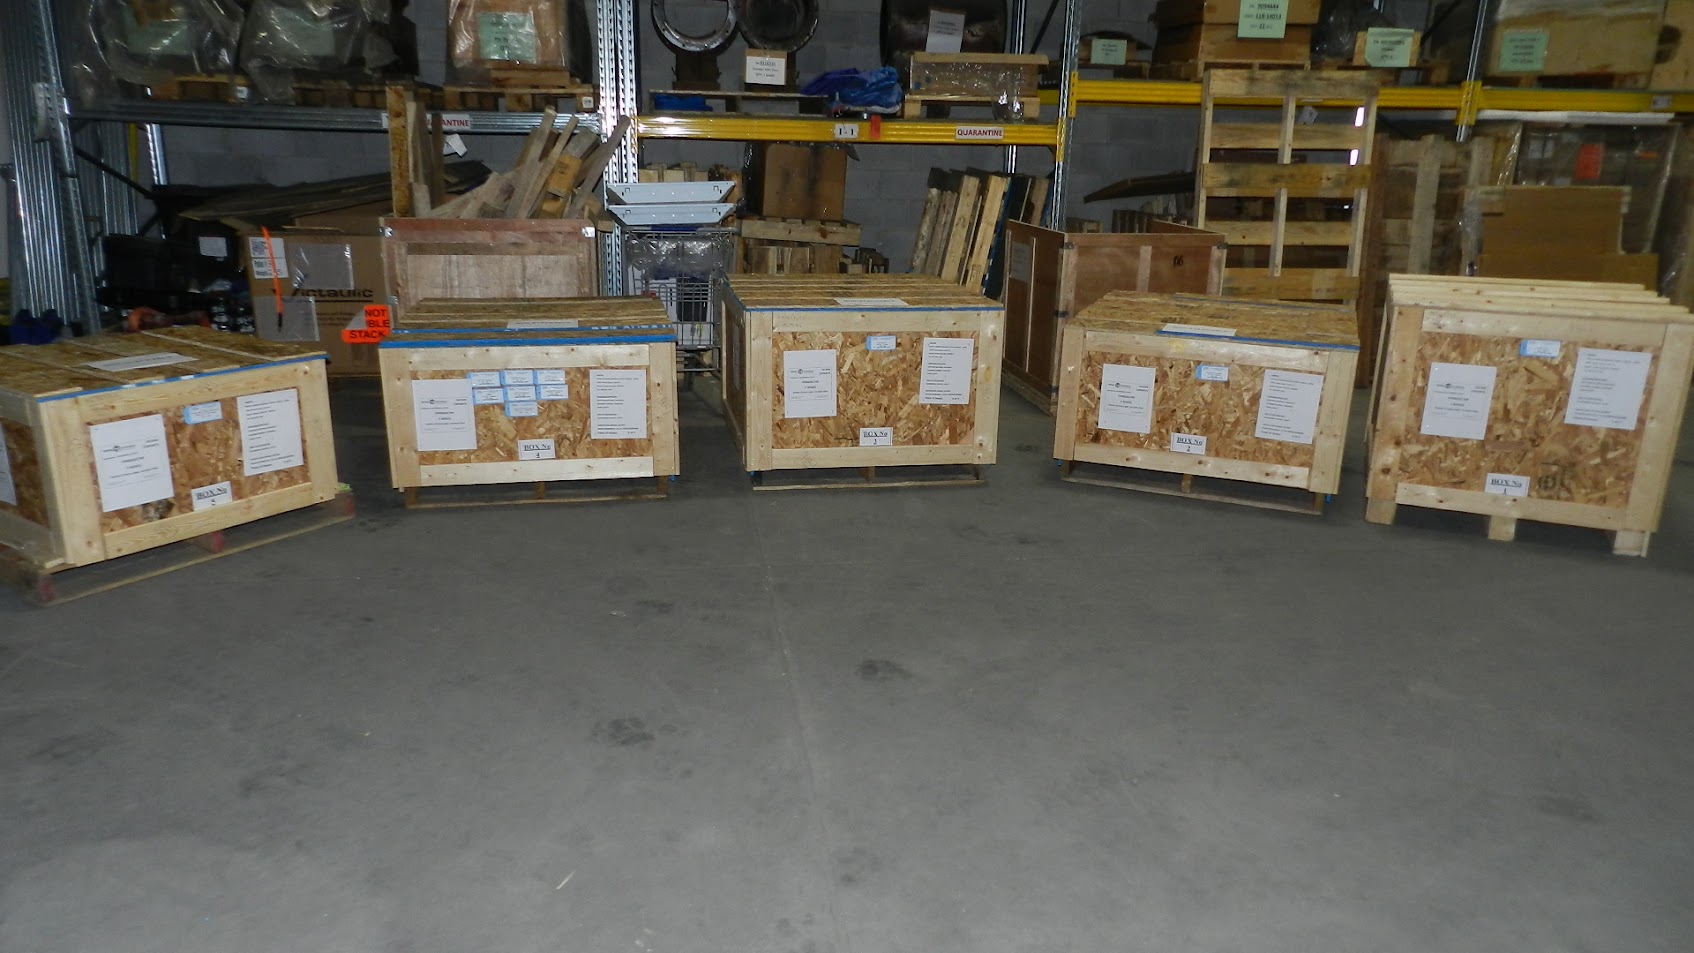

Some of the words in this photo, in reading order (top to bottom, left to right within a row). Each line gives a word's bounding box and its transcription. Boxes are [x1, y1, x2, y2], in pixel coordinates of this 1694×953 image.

[957, 128, 1003, 137] QUARANTINE
[364, 308, 386, 318] NOT
[863, 430, 879, 438] BOX
[1176, 436, 1192, 445] BOX
[524, 444, 540, 452] BOX
[1490, 478, 1510, 487] BOX
[196, 489, 215, 501] BOX
